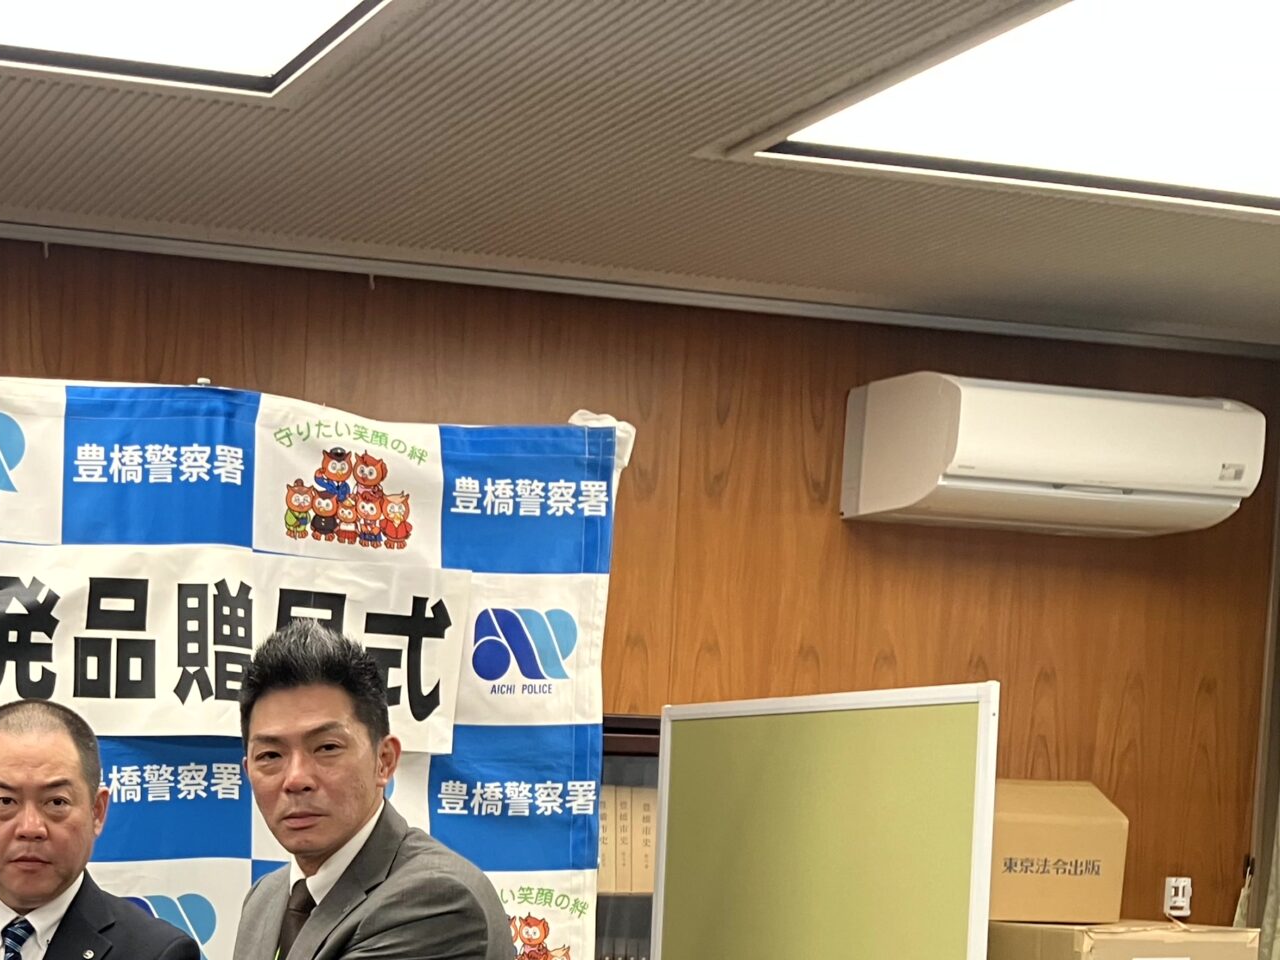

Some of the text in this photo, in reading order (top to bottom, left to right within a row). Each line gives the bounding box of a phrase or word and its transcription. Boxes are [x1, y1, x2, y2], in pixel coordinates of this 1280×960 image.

[273, 420, 429, 467] 守りたい笑顔の絆
[73, 442, 245, 487] 豊橋警察署
[451, 476, 609, 518] 豊橋警察署
[490, 683, 553, 695] AICHI POLICE
[100, 762, 242, 803] 橋警察署
[437, 779, 597, 818] 豊橋警察署
[1002, 857, 1101, 877] 東京法令出版
[500, 885, 589, 918] い笑顔の絆
